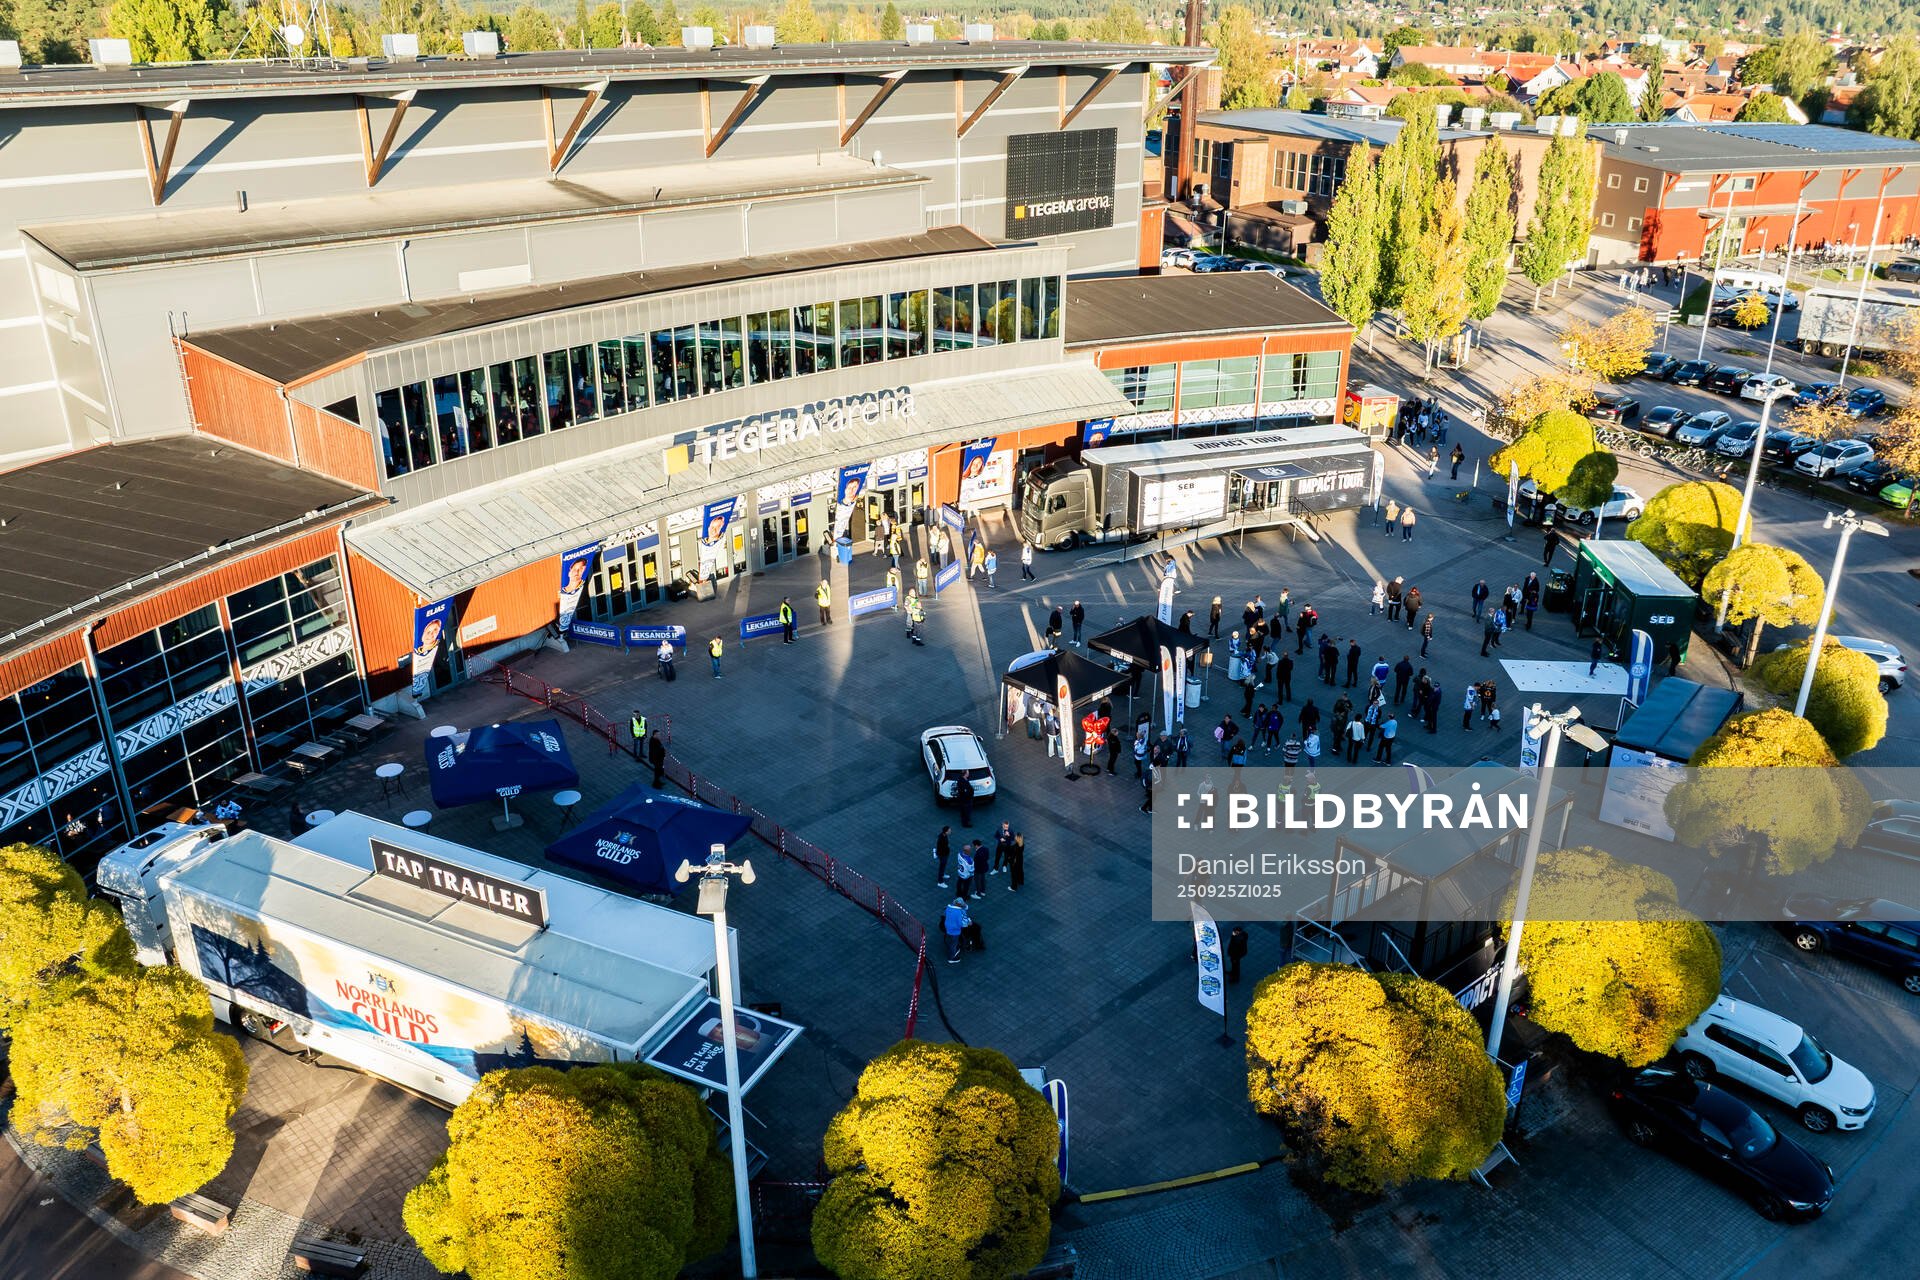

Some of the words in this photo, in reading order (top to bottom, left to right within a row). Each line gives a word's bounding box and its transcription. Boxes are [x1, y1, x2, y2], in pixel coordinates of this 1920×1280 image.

[1028, 200, 1074, 217] TEGERA
[1076, 195, 1112, 212] arena
[697, 412, 822, 465] TEGERA
[829, 393, 918, 433] arena
[1193, 440, 1248, 450] IMPACT
[1247, 435, 1288, 445] TOUR
[1298, 476, 1338, 494] IMPACT
[1338, 472, 1365, 490] TOUR
[1649, 615, 1675, 624] SEB
[573, 625, 608, 638] LEKSANDS
[608, 631, 616, 639] IF
[631, 631, 671, 639] LEKSANDS
[671, 631, 680, 639] IF
[500, 788, 520, 797] GULD
[595, 838, 642, 860] NORRLANDS
[596, 846, 632, 865] GULD
[382, 850, 424, 880] TAP
[429, 866, 532, 916] TRAILER
[335, 978, 439, 1034] NORRLANDS
[351, 1003, 430, 1044] GULD
[683, 1056, 699, 1069] En
[698, 1041, 713, 1058] kall
[694, 1056, 709, 1072] på
[707, 1044, 724, 1061] väg
[1514, 1065, 1523, 1079] P
